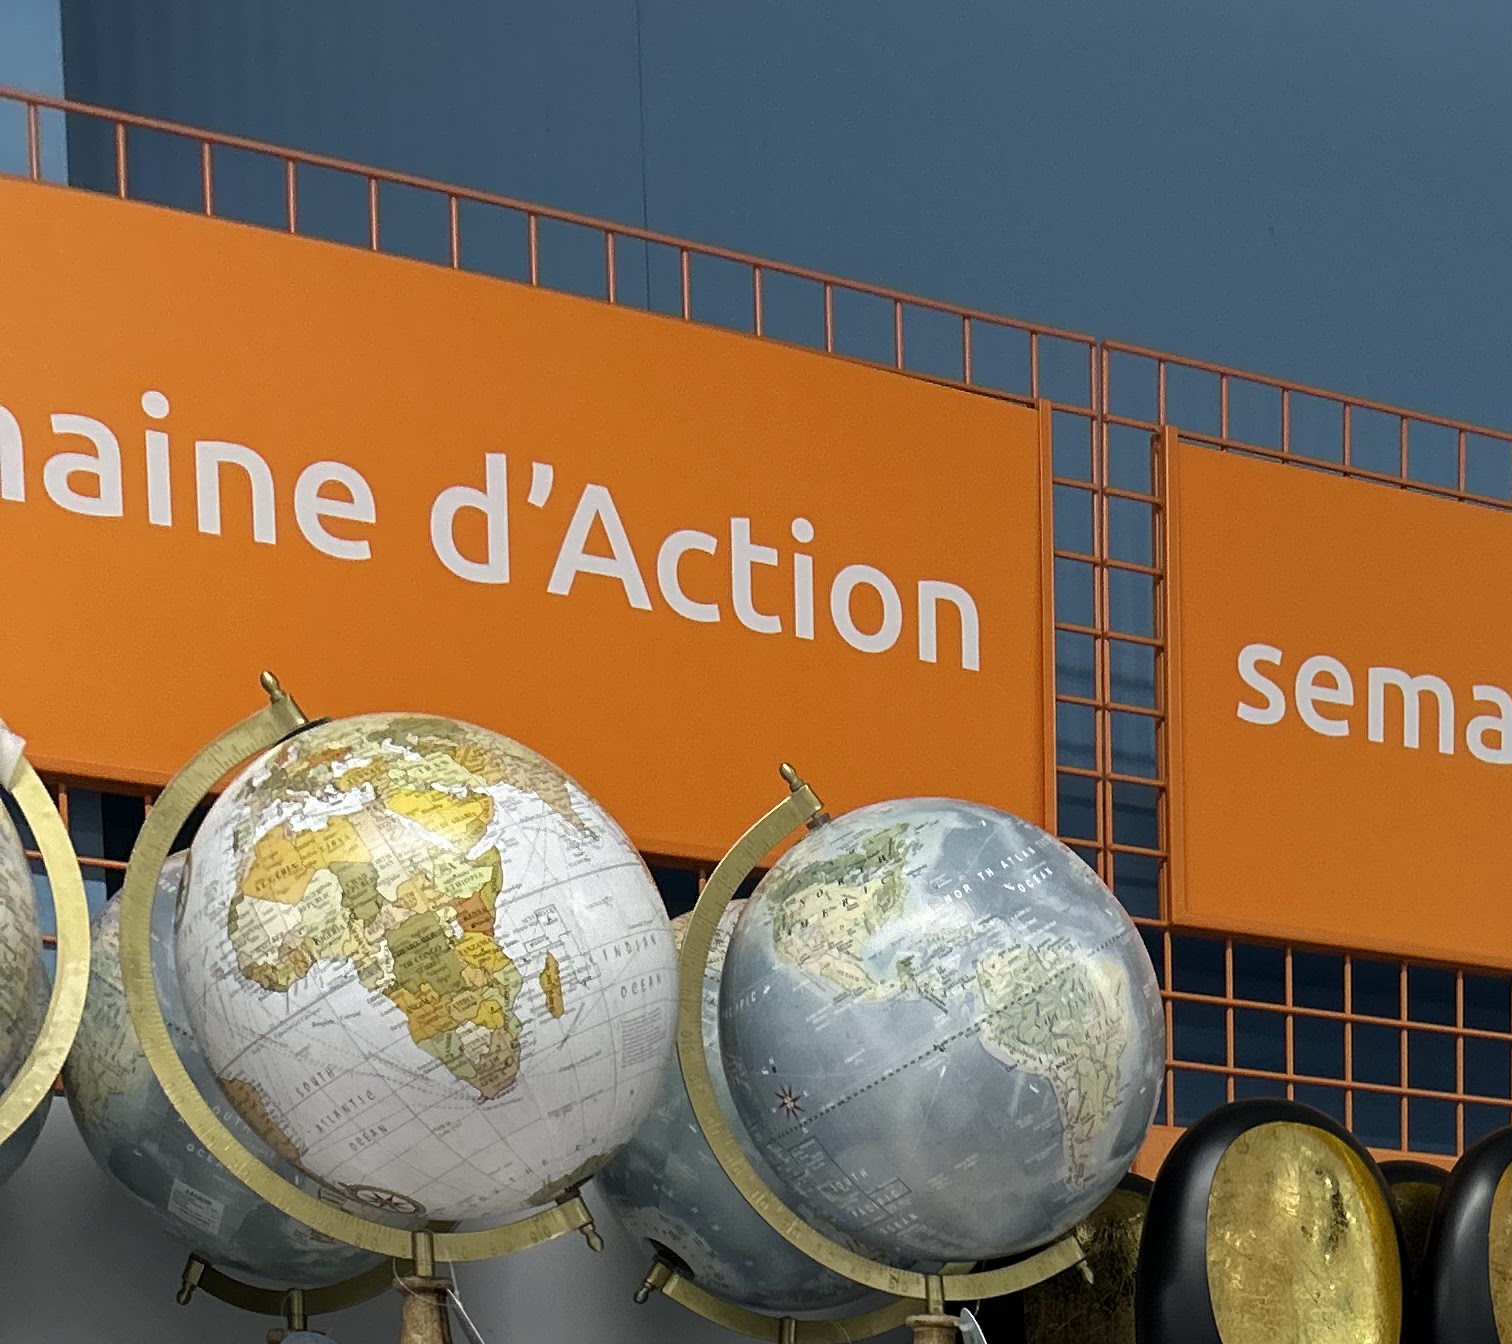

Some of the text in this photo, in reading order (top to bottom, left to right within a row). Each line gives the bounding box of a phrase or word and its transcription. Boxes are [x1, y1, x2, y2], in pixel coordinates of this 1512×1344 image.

[430, 453, 980, 672] d’Action
[619, 972, 664, 999] OCEAN
[348, 1124, 389, 1152] OCEAN
